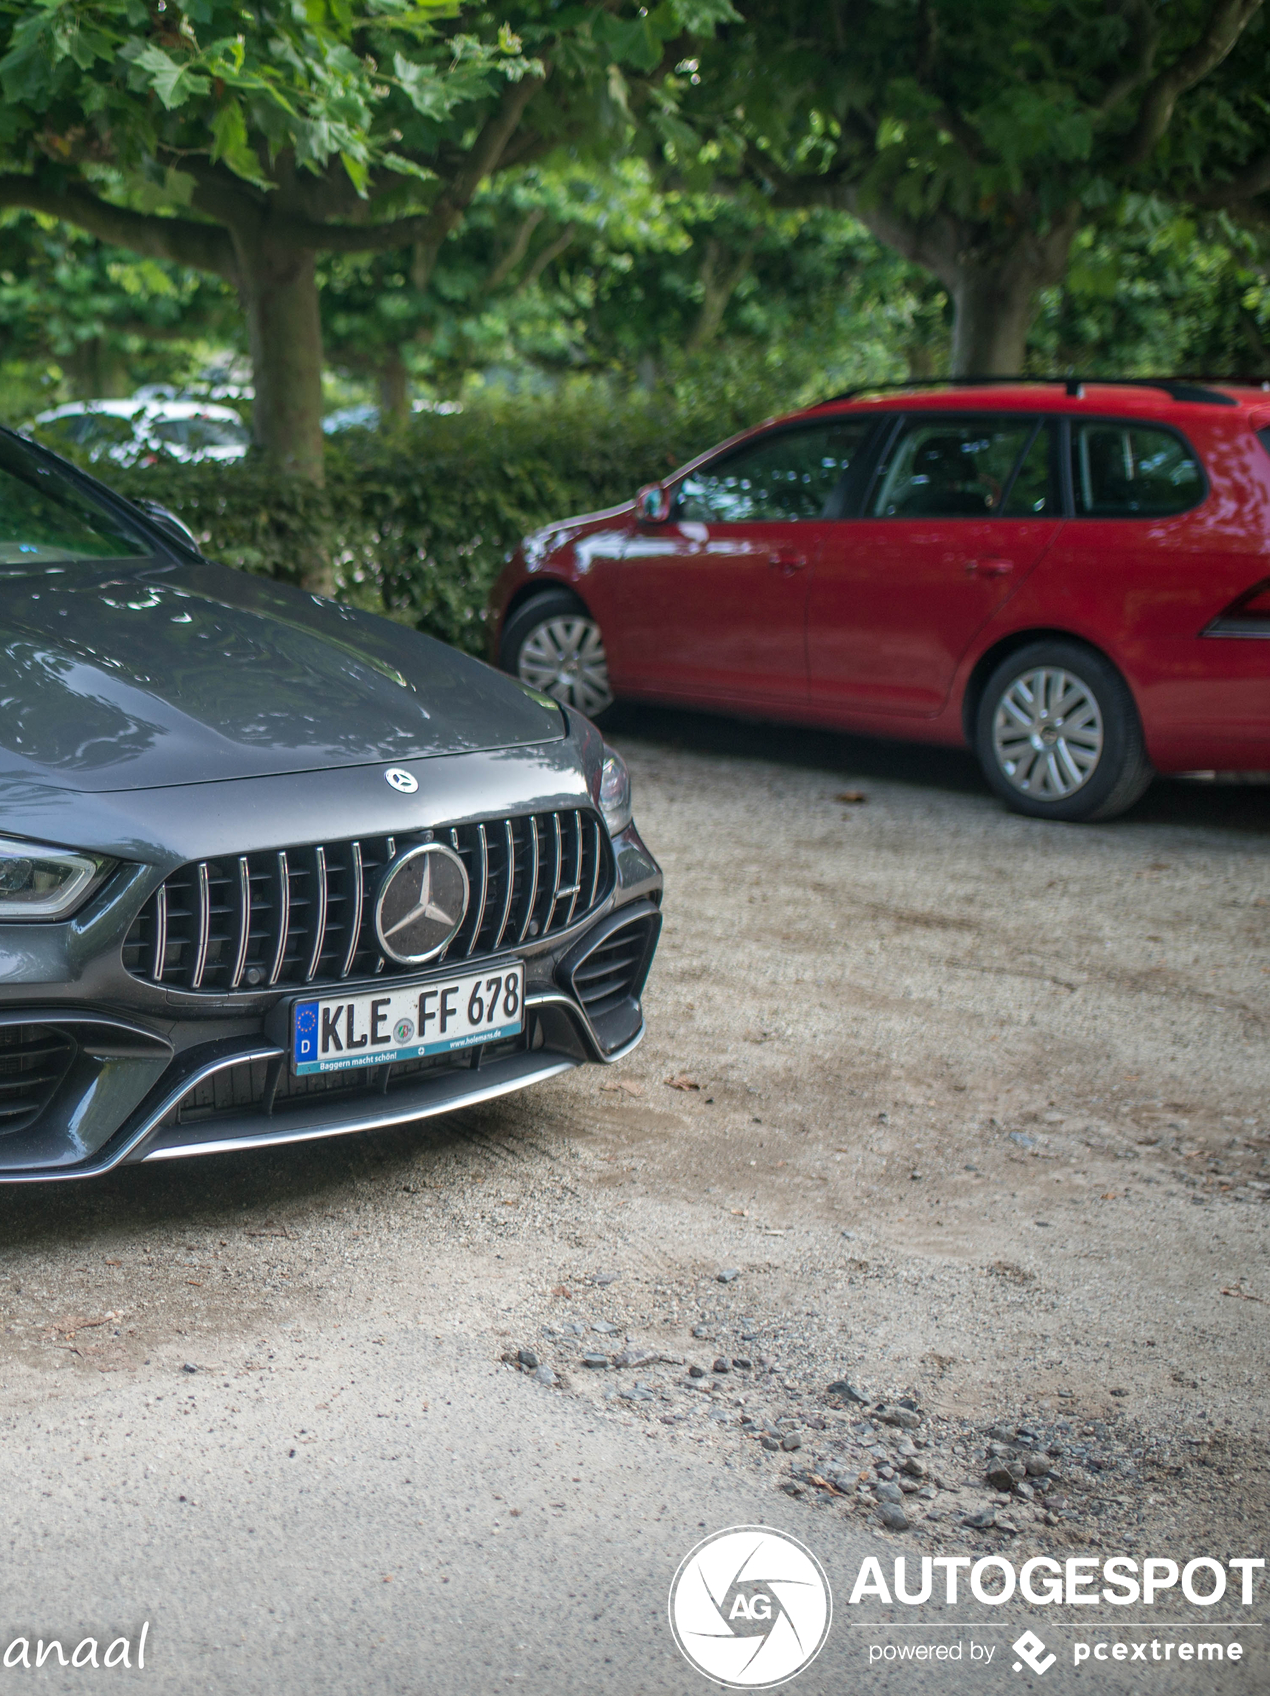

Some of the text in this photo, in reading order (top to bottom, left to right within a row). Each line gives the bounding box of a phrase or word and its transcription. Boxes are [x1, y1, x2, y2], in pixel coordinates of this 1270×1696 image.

[322, 973, 519, 1053] KLE FF 678
[301, 1039, 311, 1054] D
[320, 1051, 397, 1071] Baggern macht schön!
